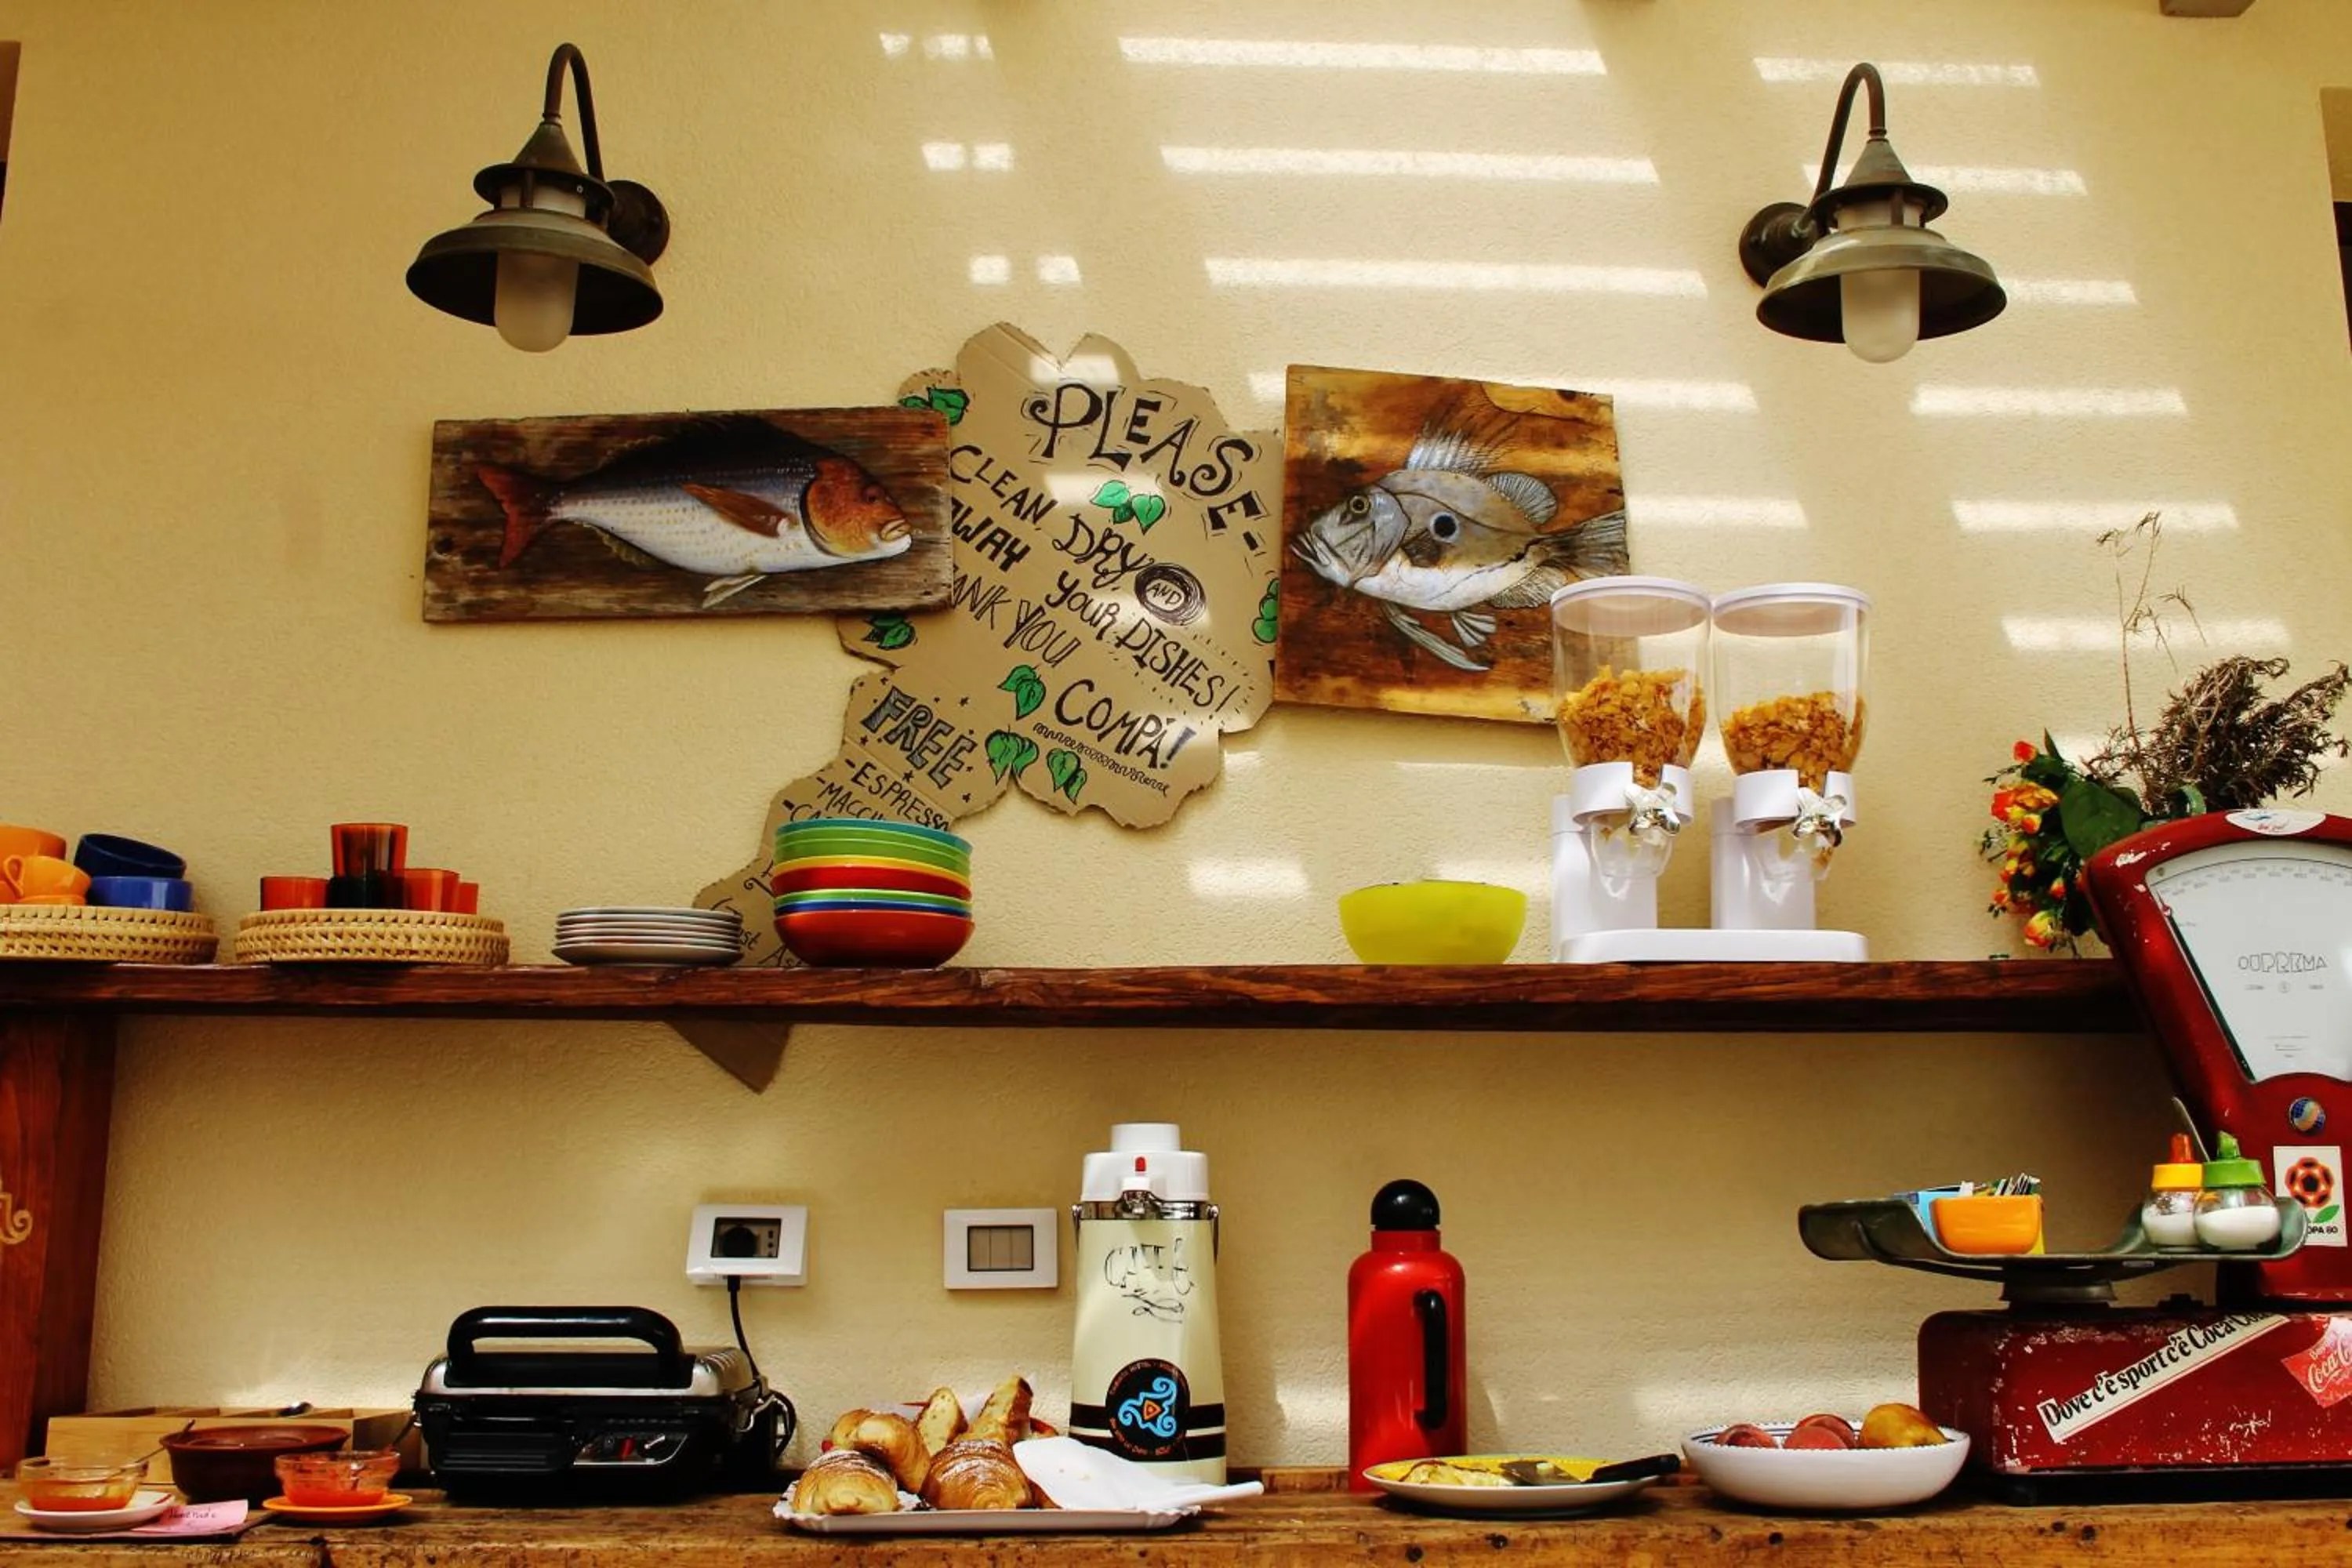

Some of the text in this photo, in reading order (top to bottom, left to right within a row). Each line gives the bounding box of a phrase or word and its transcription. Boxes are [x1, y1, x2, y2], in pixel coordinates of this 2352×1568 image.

[860, 685, 979, 789] FREE
[2040, 1392, 2092, 1427] Dove
[2117, 1350, 2169, 1390] sport
